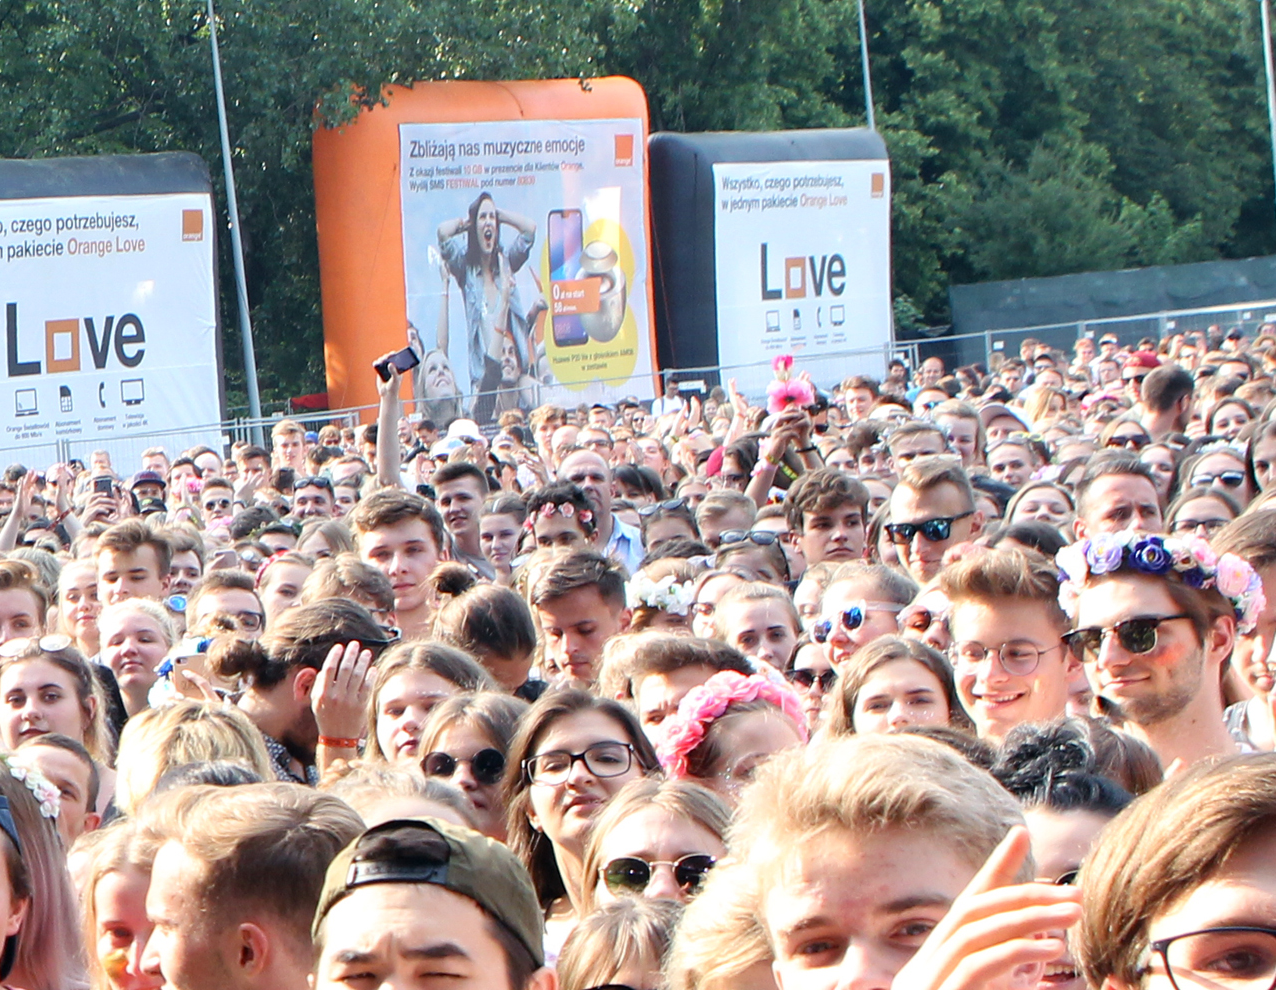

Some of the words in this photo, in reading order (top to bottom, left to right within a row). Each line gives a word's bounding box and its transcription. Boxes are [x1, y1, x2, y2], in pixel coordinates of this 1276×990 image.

[409, 140, 455, 161] Zbliżają
[458, 142, 480, 157] nas
[483, 140, 543, 158] muzyczne
[545, 135, 585, 156] emocje
[484, 166, 490, 174] w
[491, 163, 523, 176] prezencie
[429, 178, 445, 189] SMS
[446, 177, 479, 189] FESTIWAL
[480, 176, 493, 188] pod
[495, 177, 516, 187] numer
[722, 176, 763, 193] Wszystko,
[765, 177, 790, 192] czego
[793, 175, 844, 190] potrzebujesz,
[722, 200, 729, 210] w
[730, 197, 760, 213] jednym
[761, 195, 798, 211] pakiecie
[800, 193, 827, 210] Orange
[829, 193, 848, 206] Love
[11, 216, 52, 236] czego
[56, 212, 139, 234] potrzebujesz,
[7, 238, 63, 262] pakiecie
[67, 237, 112, 257] Orange
[116, 236, 145, 252] Love
[761, 242, 847, 301] Love
[553, 284, 560, 300] 0
[6, 301, 146, 378] Love
